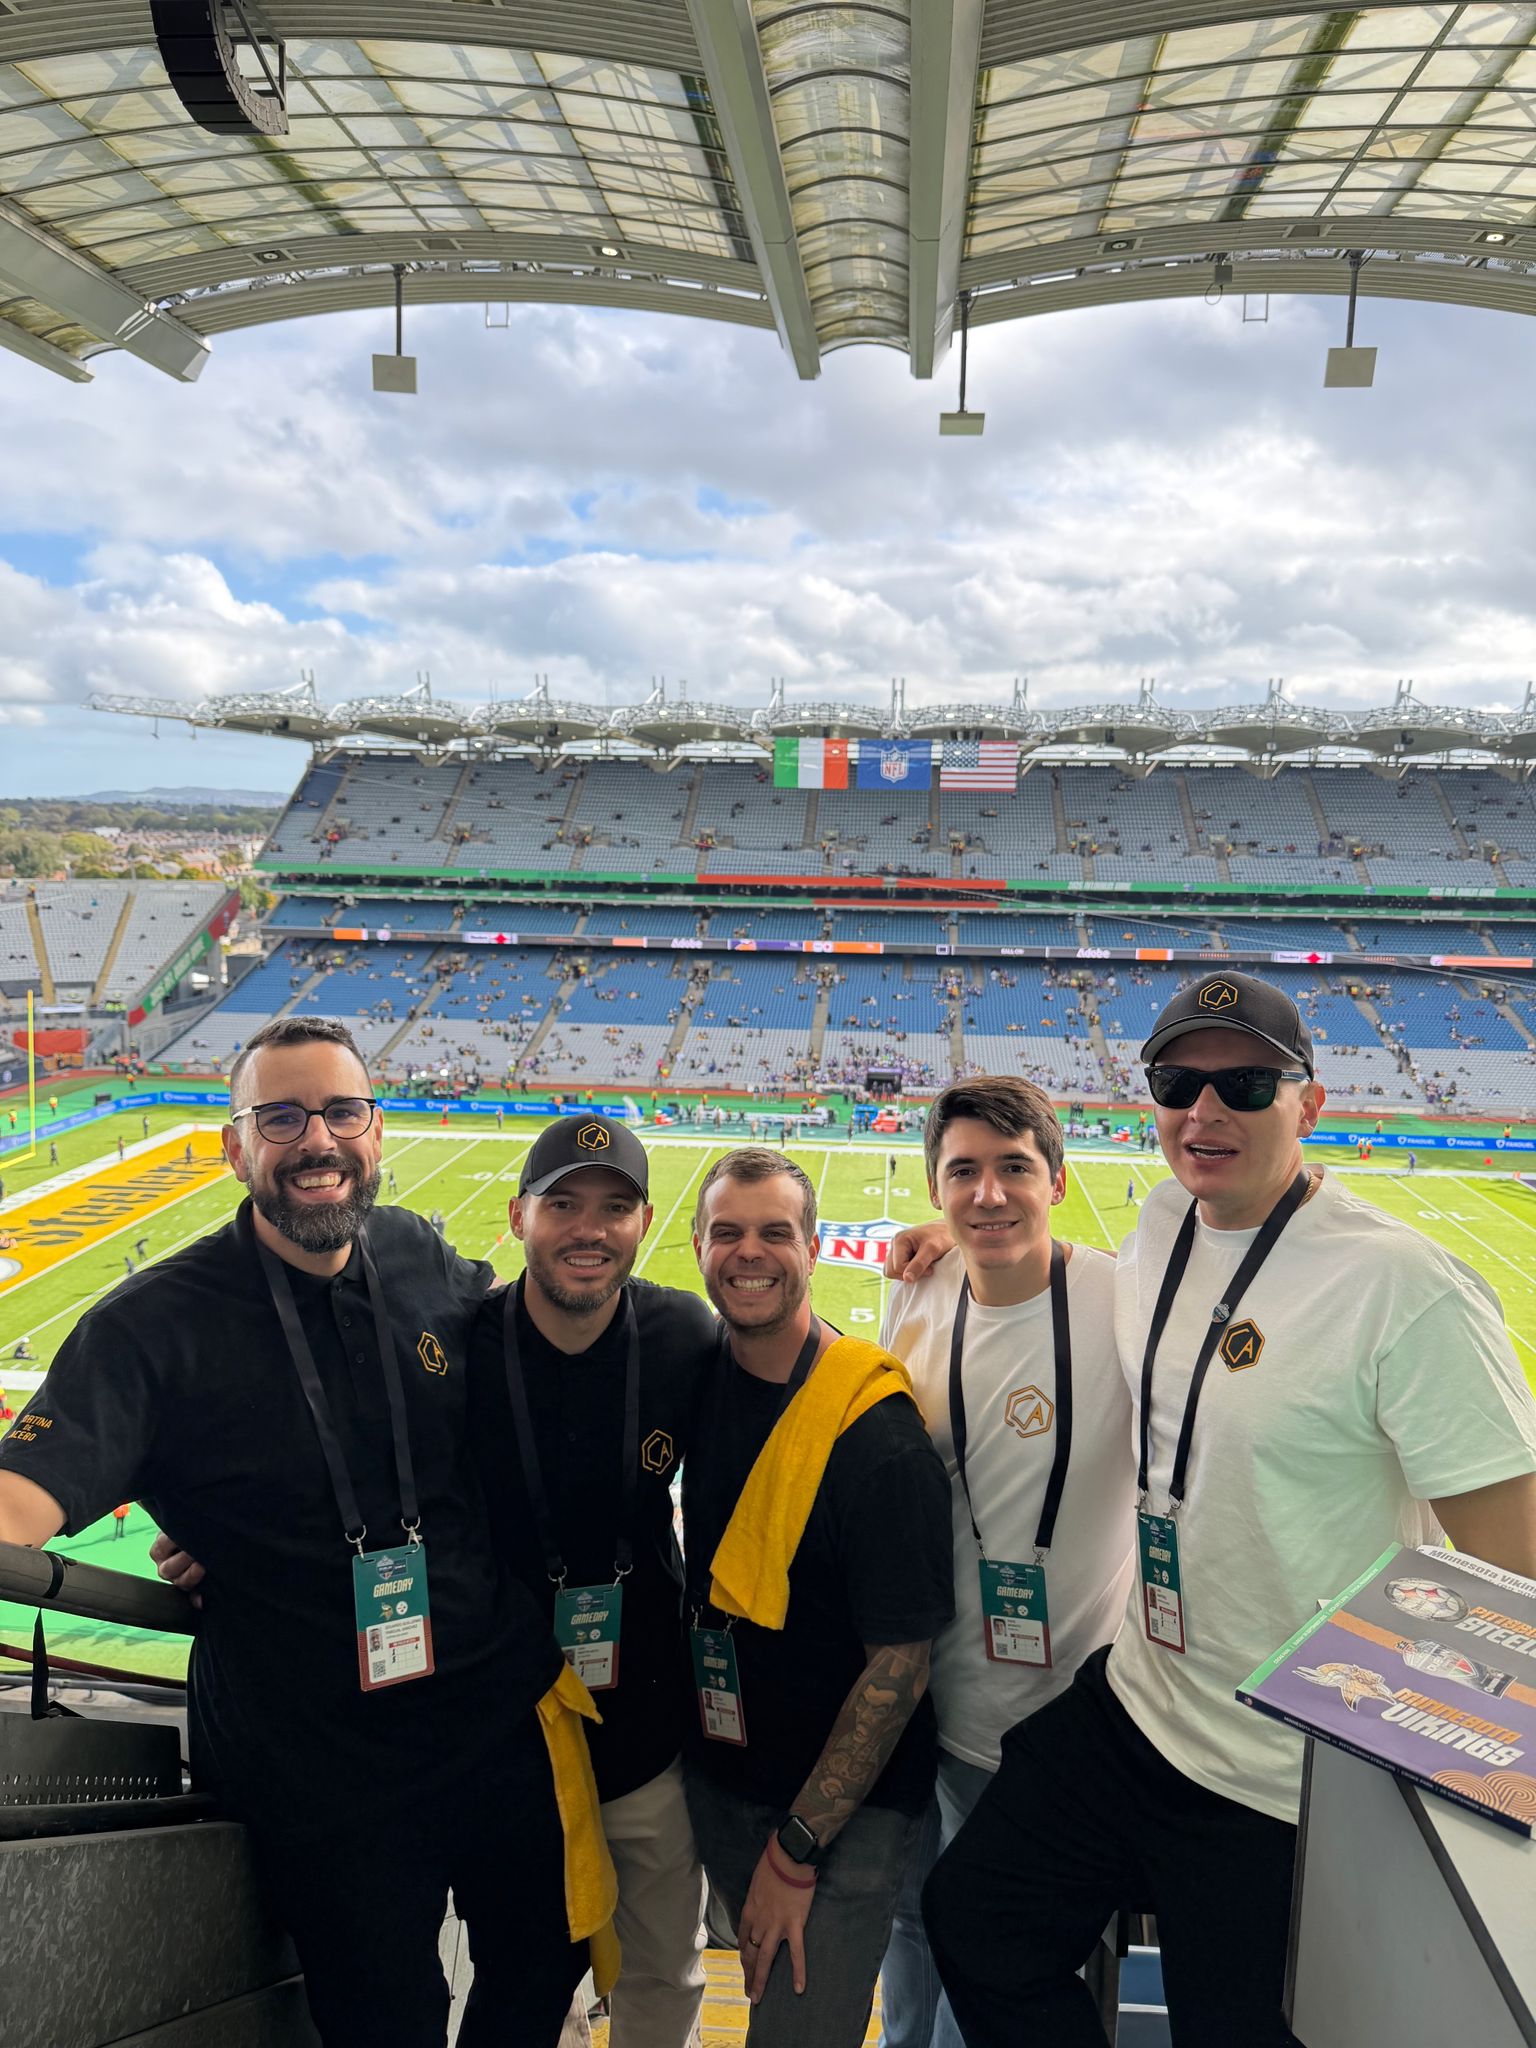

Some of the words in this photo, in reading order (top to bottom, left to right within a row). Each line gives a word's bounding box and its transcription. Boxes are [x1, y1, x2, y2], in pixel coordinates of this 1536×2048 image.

[883, 762, 906, 777] NFL
[670, 938, 703, 949] Adobe
[1076, 947, 1111, 959] Adobe
[830, 1238, 891, 1264] NF
[849, 1307, 876, 1323] 5
[1428, 1549, 1498, 1579] Minnesota
[1500, 1574, 1536, 1594] Vikin
[373, 1577, 414, 1598] GAMEDAY
[996, 1586, 1034, 1600] GAMEDAY
[570, 1610, 610, 1625] GAMEDAY
[1283, 1715, 1311, 1732] MINNESOTA
[1394, 1687, 1522, 1744] MINNESOTA
[1381, 1703, 1525, 1767] VIKINGS
